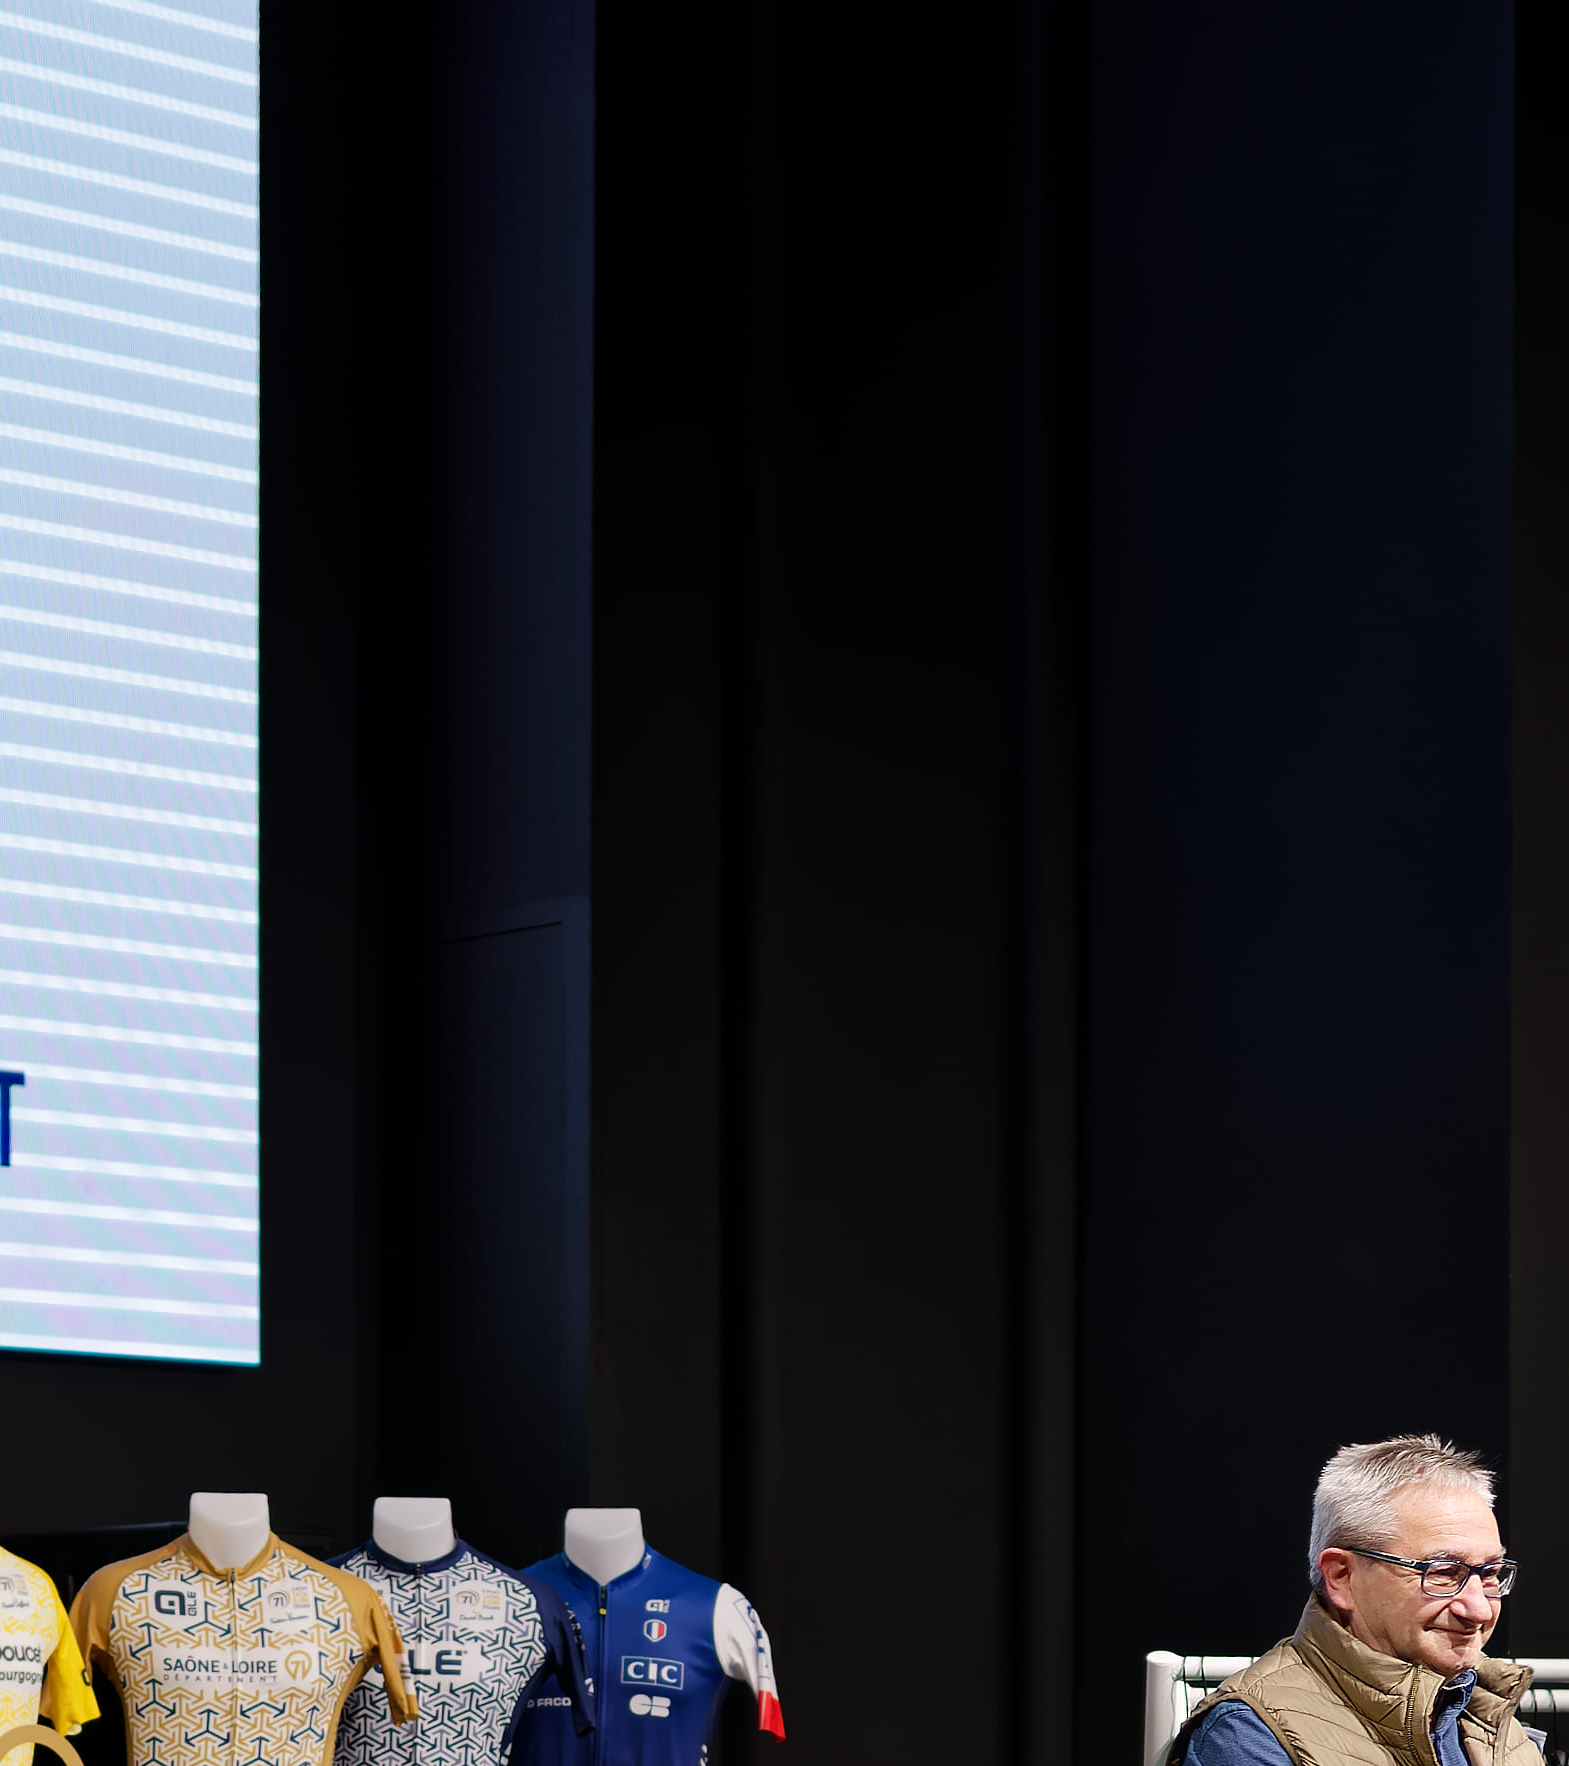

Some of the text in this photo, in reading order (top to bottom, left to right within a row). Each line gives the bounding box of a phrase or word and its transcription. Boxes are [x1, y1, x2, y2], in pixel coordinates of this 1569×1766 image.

[163, 1655, 221, 1673] SAÔNE
[231, 1660, 278, 1675] LOIRE
[627, 1661, 679, 1684] CIC
